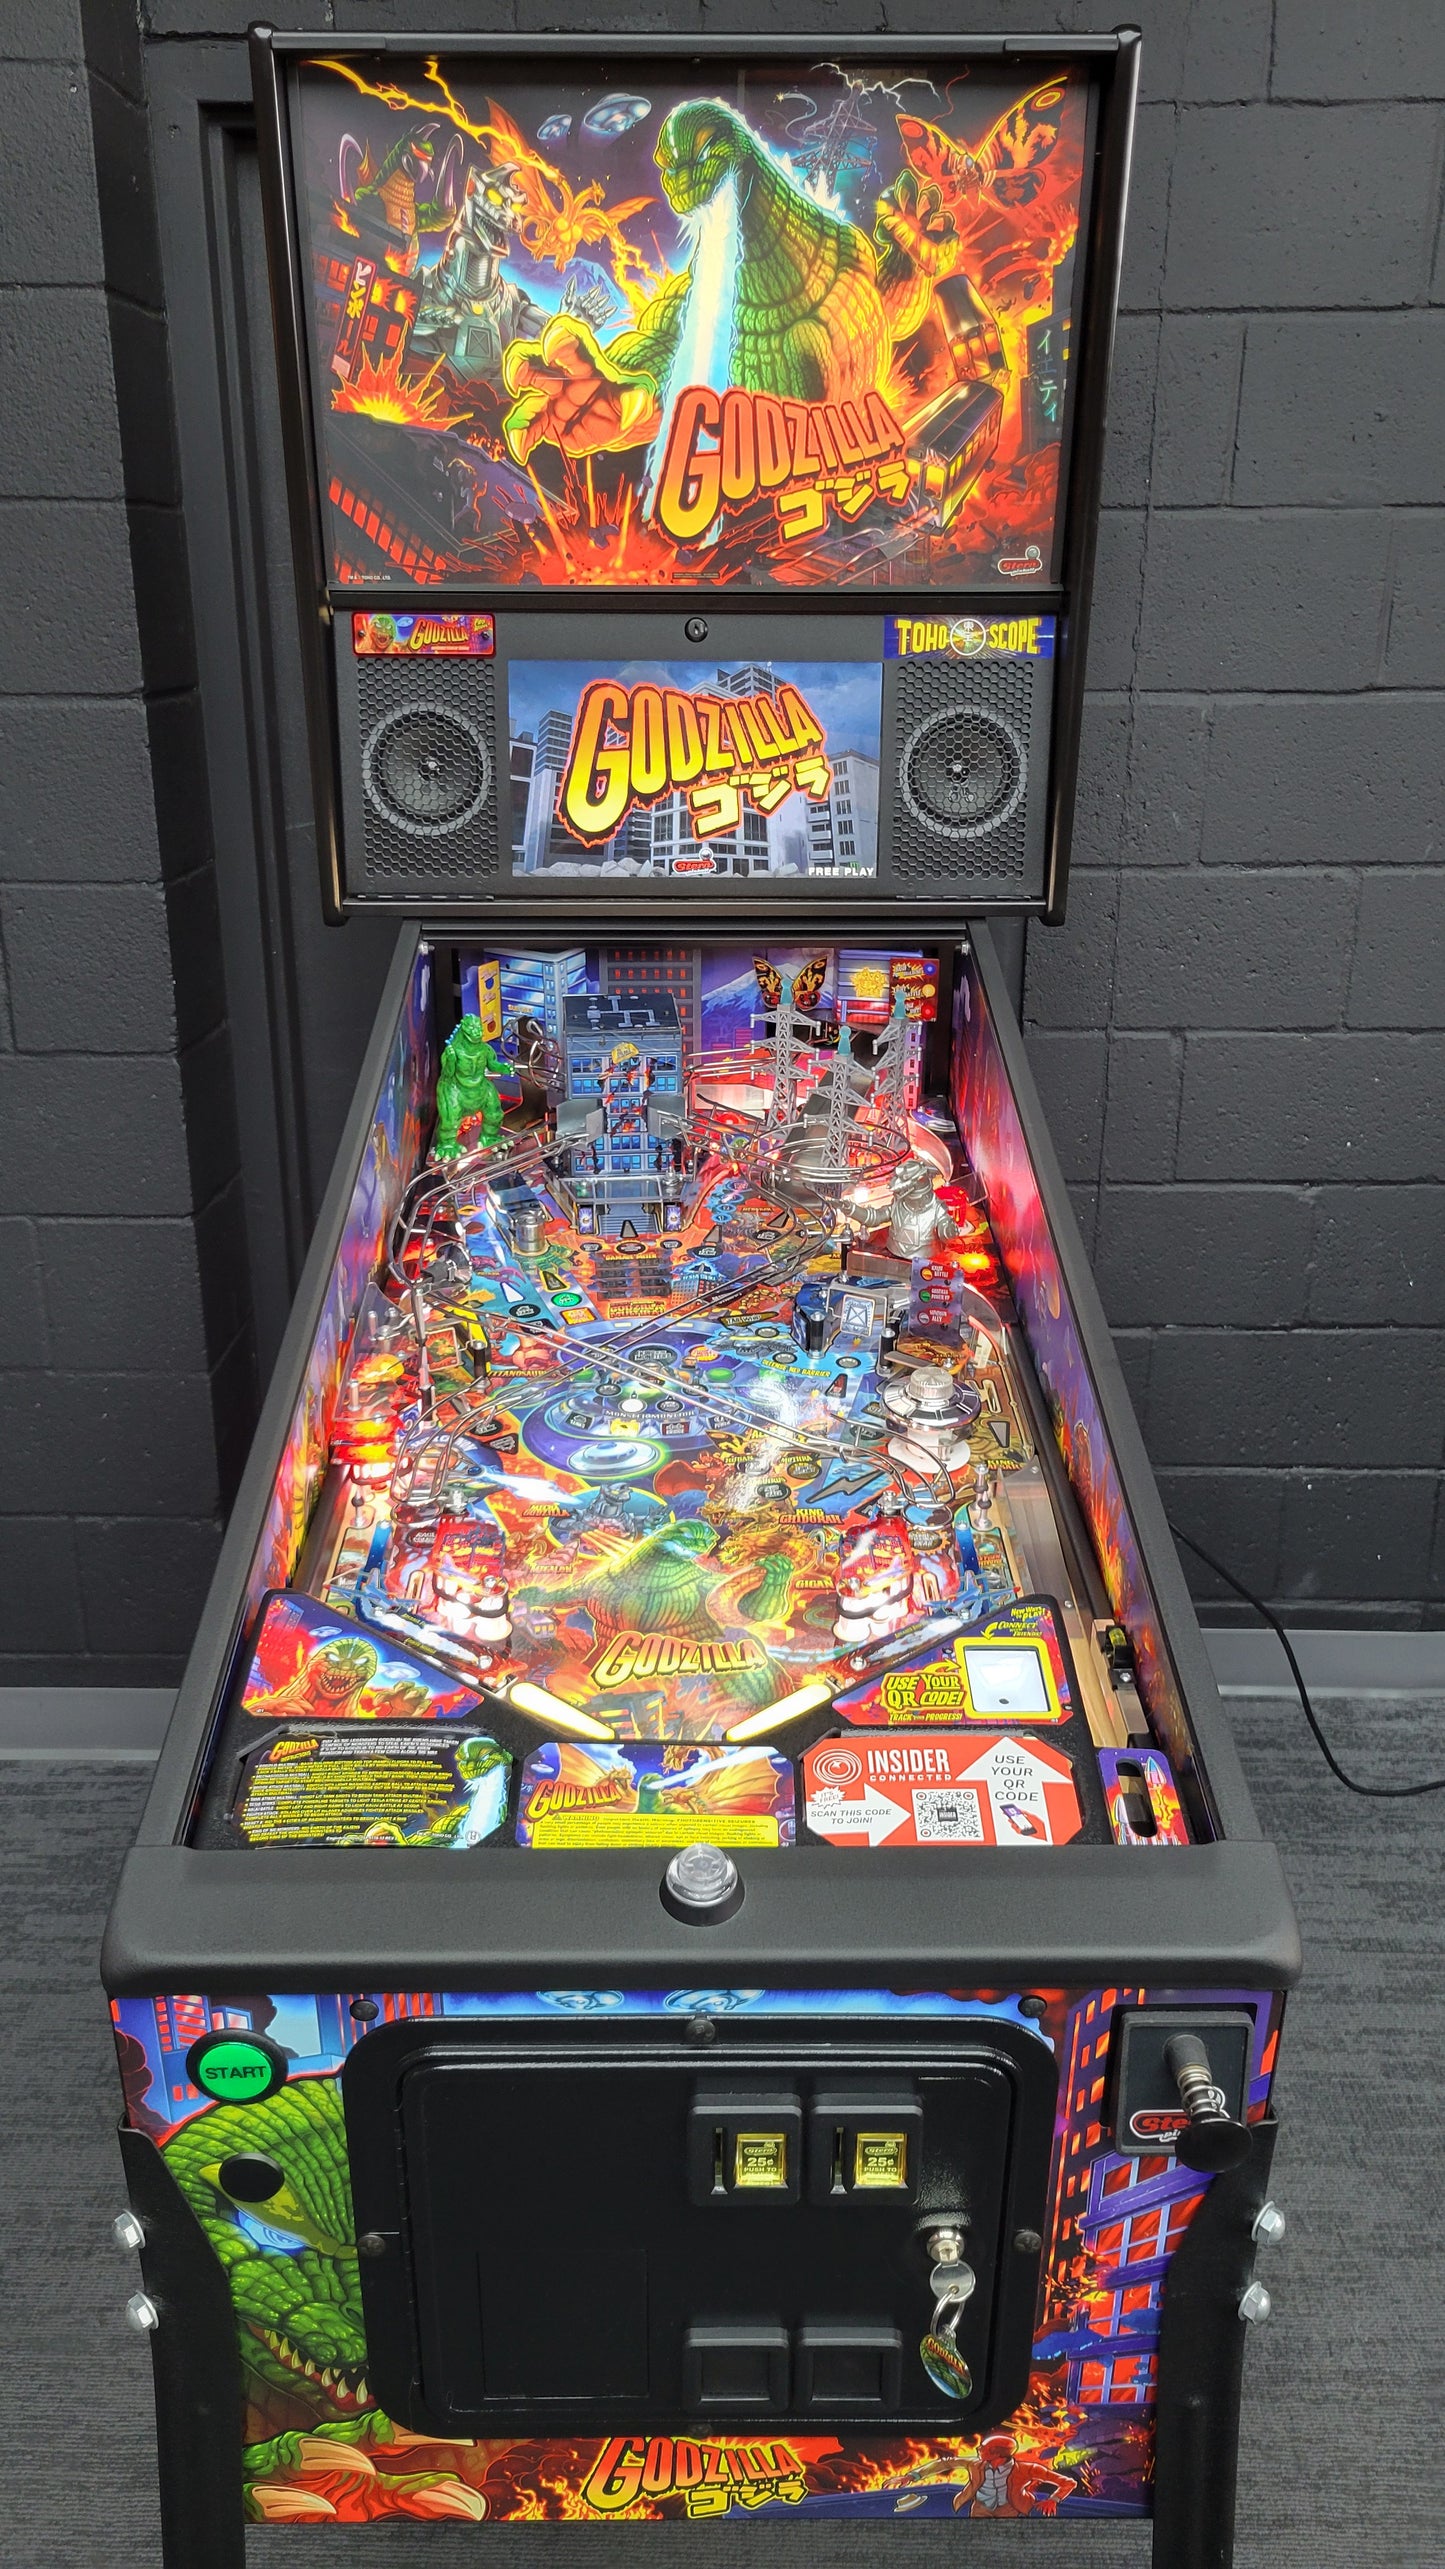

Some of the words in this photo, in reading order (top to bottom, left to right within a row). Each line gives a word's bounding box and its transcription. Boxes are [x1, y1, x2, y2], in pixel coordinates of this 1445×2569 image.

[657, 387, 907, 539] GODZILLA
[779, 464, 909, 540] ゴジラ
[408, 617, 470, 651] GODZILLA
[894, 618, 950, 656] TOHO
[988, 617, 1042, 655] SCOPE
[564, 684, 824, 834] GODZILLA
[691, 755, 830, 837] ゴジラ
[808, 866, 840, 877] FREE
[844, 866, 875, 877] PLAY
[795, 1508, 825, 1516] KING
[779, 1515, 843, 1524] GHIDORAH
[795, 1580, 834, 1589] GIGAN
[1022, 1610, 1046, 1621] PLAY!
[998, 1622, 1038, 1631] CONNECT
[594, 1632, 767, 1688] GODZILLA
[886, 1676, 920, 1691] USE
[922, 1673, 960, 1689] YOUR
[887, 1690, 917, 1707] QR
[919, 1690, 964, 1706] CODE!
[889, 1712, 912, 1722] TRACK
[925, 1712, 963, 1722] PROGRESS!
[268, 1738, 320, 1763] GODZILLA
[866, 1748, 951, 1774] INSIDER
[994, 1754, 1026, 1765] USE
[991, 1766, 1034, 1777] YOUR
[869, 1774, 952, 1782] CONNECTED
[1003, 1779, 1026, 1790] QR
[526, 1779, 623, 1821] GODZILLA
[819, 1790, 835, 1799] IT'S
[819, 1794, 841, 1804] FREE!
[994, 1791, 1040, 1802] CODE
[810, 1810, 837, 1818] SCAN
[840, 1808, 866, 1818] THIS
[867, 1808, 892, 1816] CODE
[831, 1817, 844, 1826] TO
[846, 1816, 874, 1825] JOIN!
[205, 2065, 268, 2081] START
[747, 2157, 774, 2167] 25¢
[868, 2157, 895, 2167] 25¢
[927, 2337, 965, 2374] GODZILLA
[585, 2435, 802, 2509] GODZILLA
[688, 2478, 809, 2518] ゴジラ
